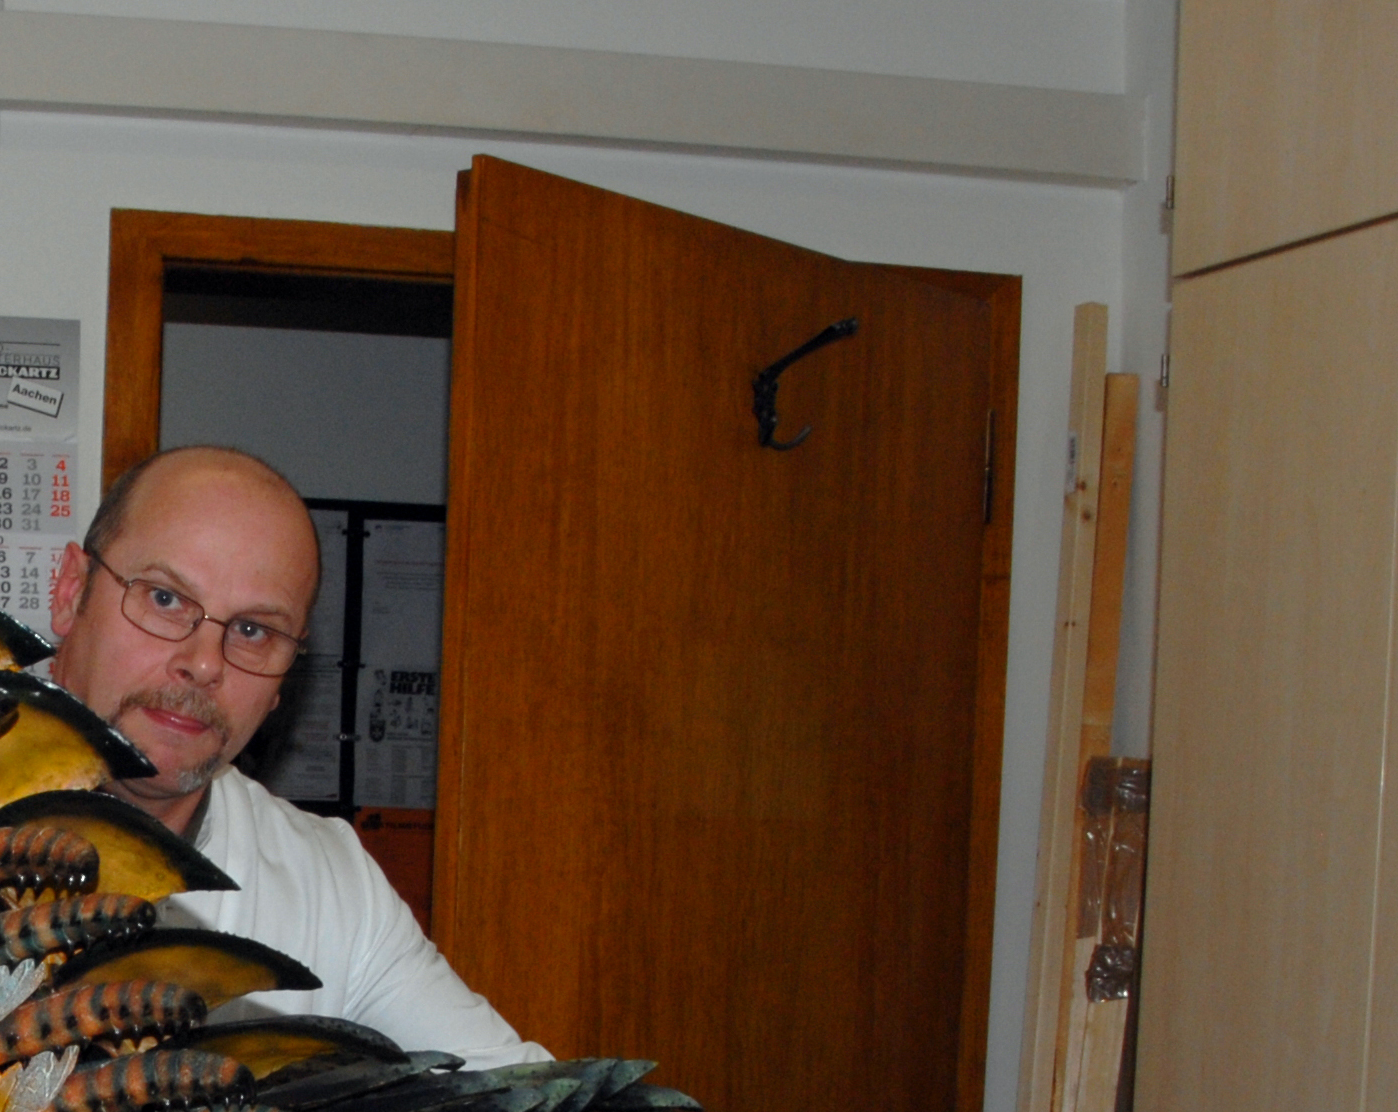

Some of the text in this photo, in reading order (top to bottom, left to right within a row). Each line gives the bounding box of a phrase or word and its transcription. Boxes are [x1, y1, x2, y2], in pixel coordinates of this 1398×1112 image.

[12, 384, 57, 406] Aachen
[27, 458, 37, 470] 3
[56, 460, 66, 471] 4
[23, 474, 41, 486] 10
[53, 475, 69, 487] 11
[22, 488, 41, 500] 17
[52, 490, 70, 502] 18
[21, 503, 41, 515] 24
[50, 505, 71, 517] 25
[22, 519, 41, 531] 31
[26, 552, 35, 564] 7
[21, 567, 39, 579] 14
[20, 582, 39, 594] 21
[19, 597, 39, 610] 28
[390, 671, 436, 683] ERSTE
[389, 683, 436, 695] HILFE
